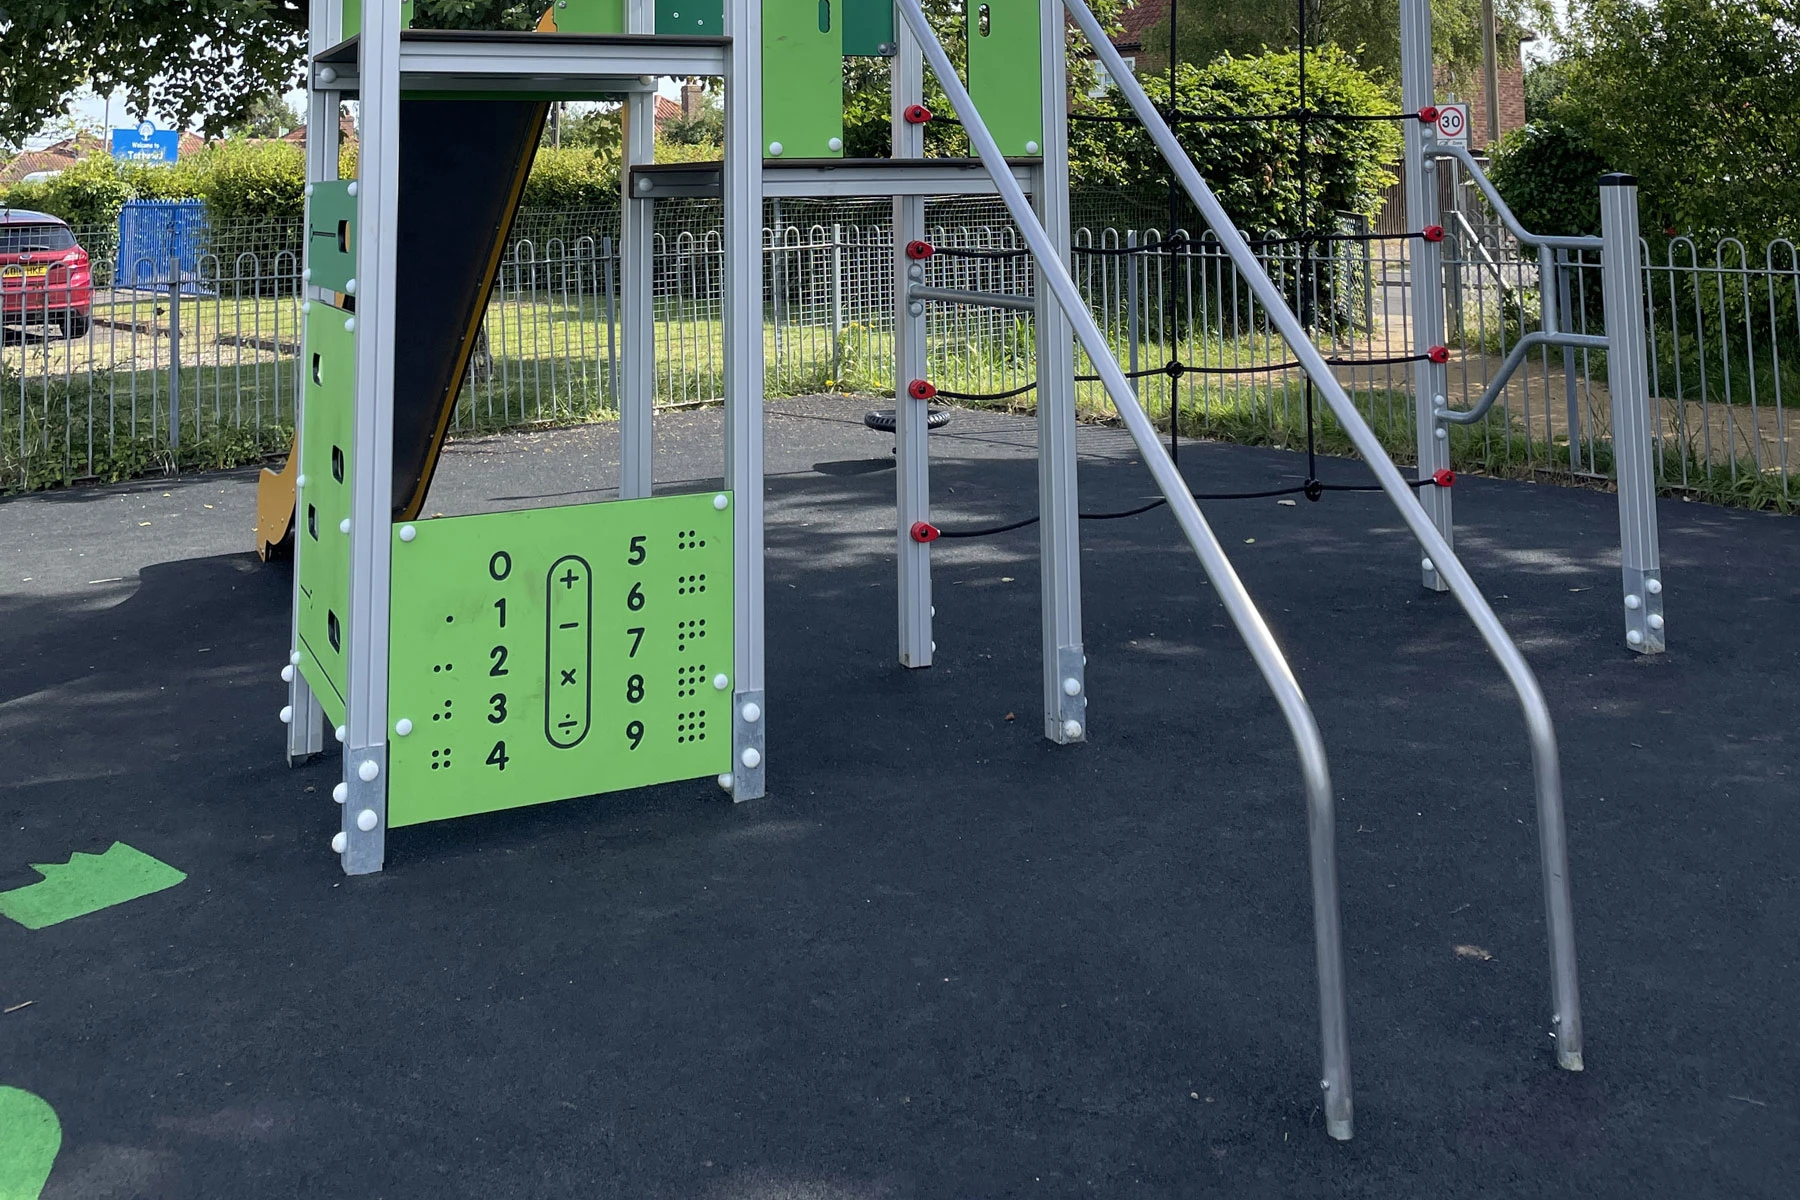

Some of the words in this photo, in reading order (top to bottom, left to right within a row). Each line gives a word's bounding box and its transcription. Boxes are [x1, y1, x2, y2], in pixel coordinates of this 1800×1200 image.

[1442, 115, 1460, 128] 30
[489, 551, 511, 581] 0
[628, 536, 647, 566] 5
[627, 582, 646, 611] 6
[494, 598, 507, 628] 1
[627, 627, 646, 658] 7
[489, 646, 509, 677] 2
[626, 674, 645, 704] 8
[487, 693, 508, 724] 3
[626, 720, 645, 750] 9
[485, 740, 510, 771] 4
